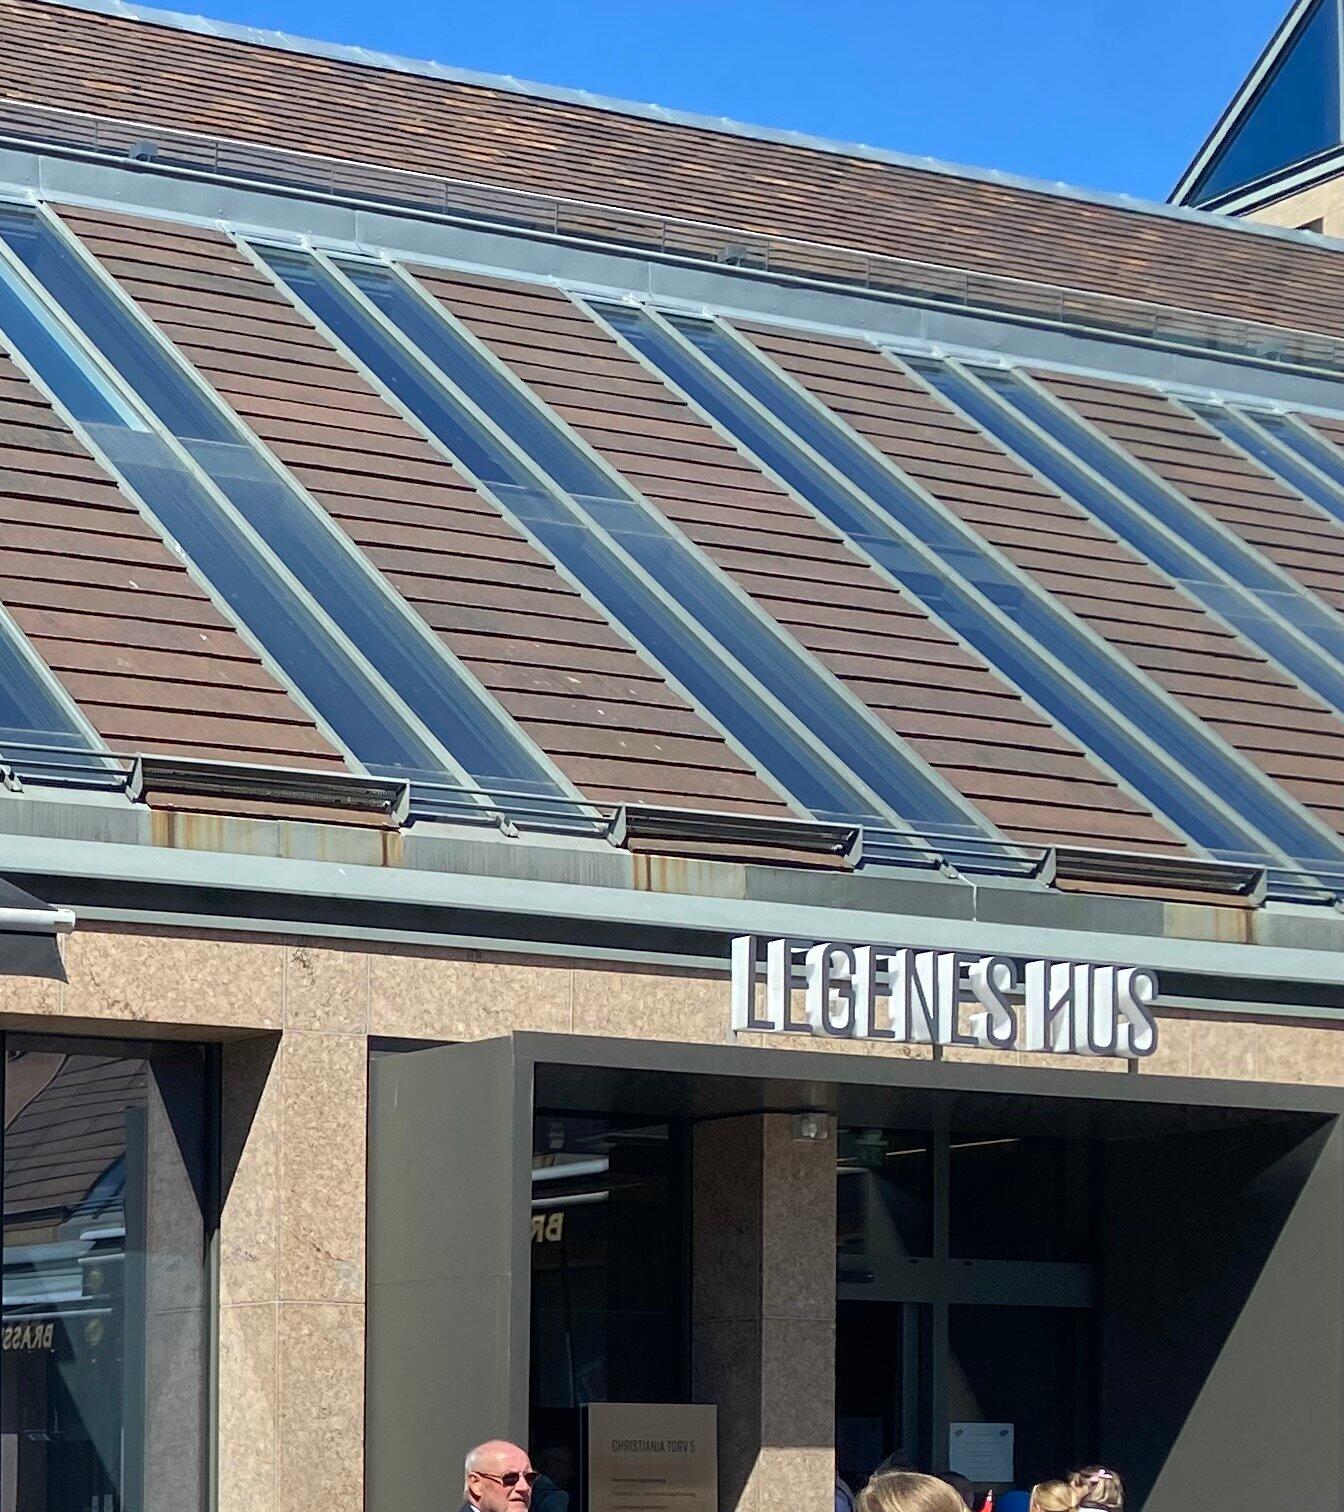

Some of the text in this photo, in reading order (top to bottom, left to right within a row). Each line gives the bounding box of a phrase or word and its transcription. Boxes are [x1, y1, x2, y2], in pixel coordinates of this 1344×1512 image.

[730, 934, 1017, 1050] LEGENES
[611, 1439, 665, 1453] CHRISTIANIA
[667, 1440, 689, 1453] TORV
